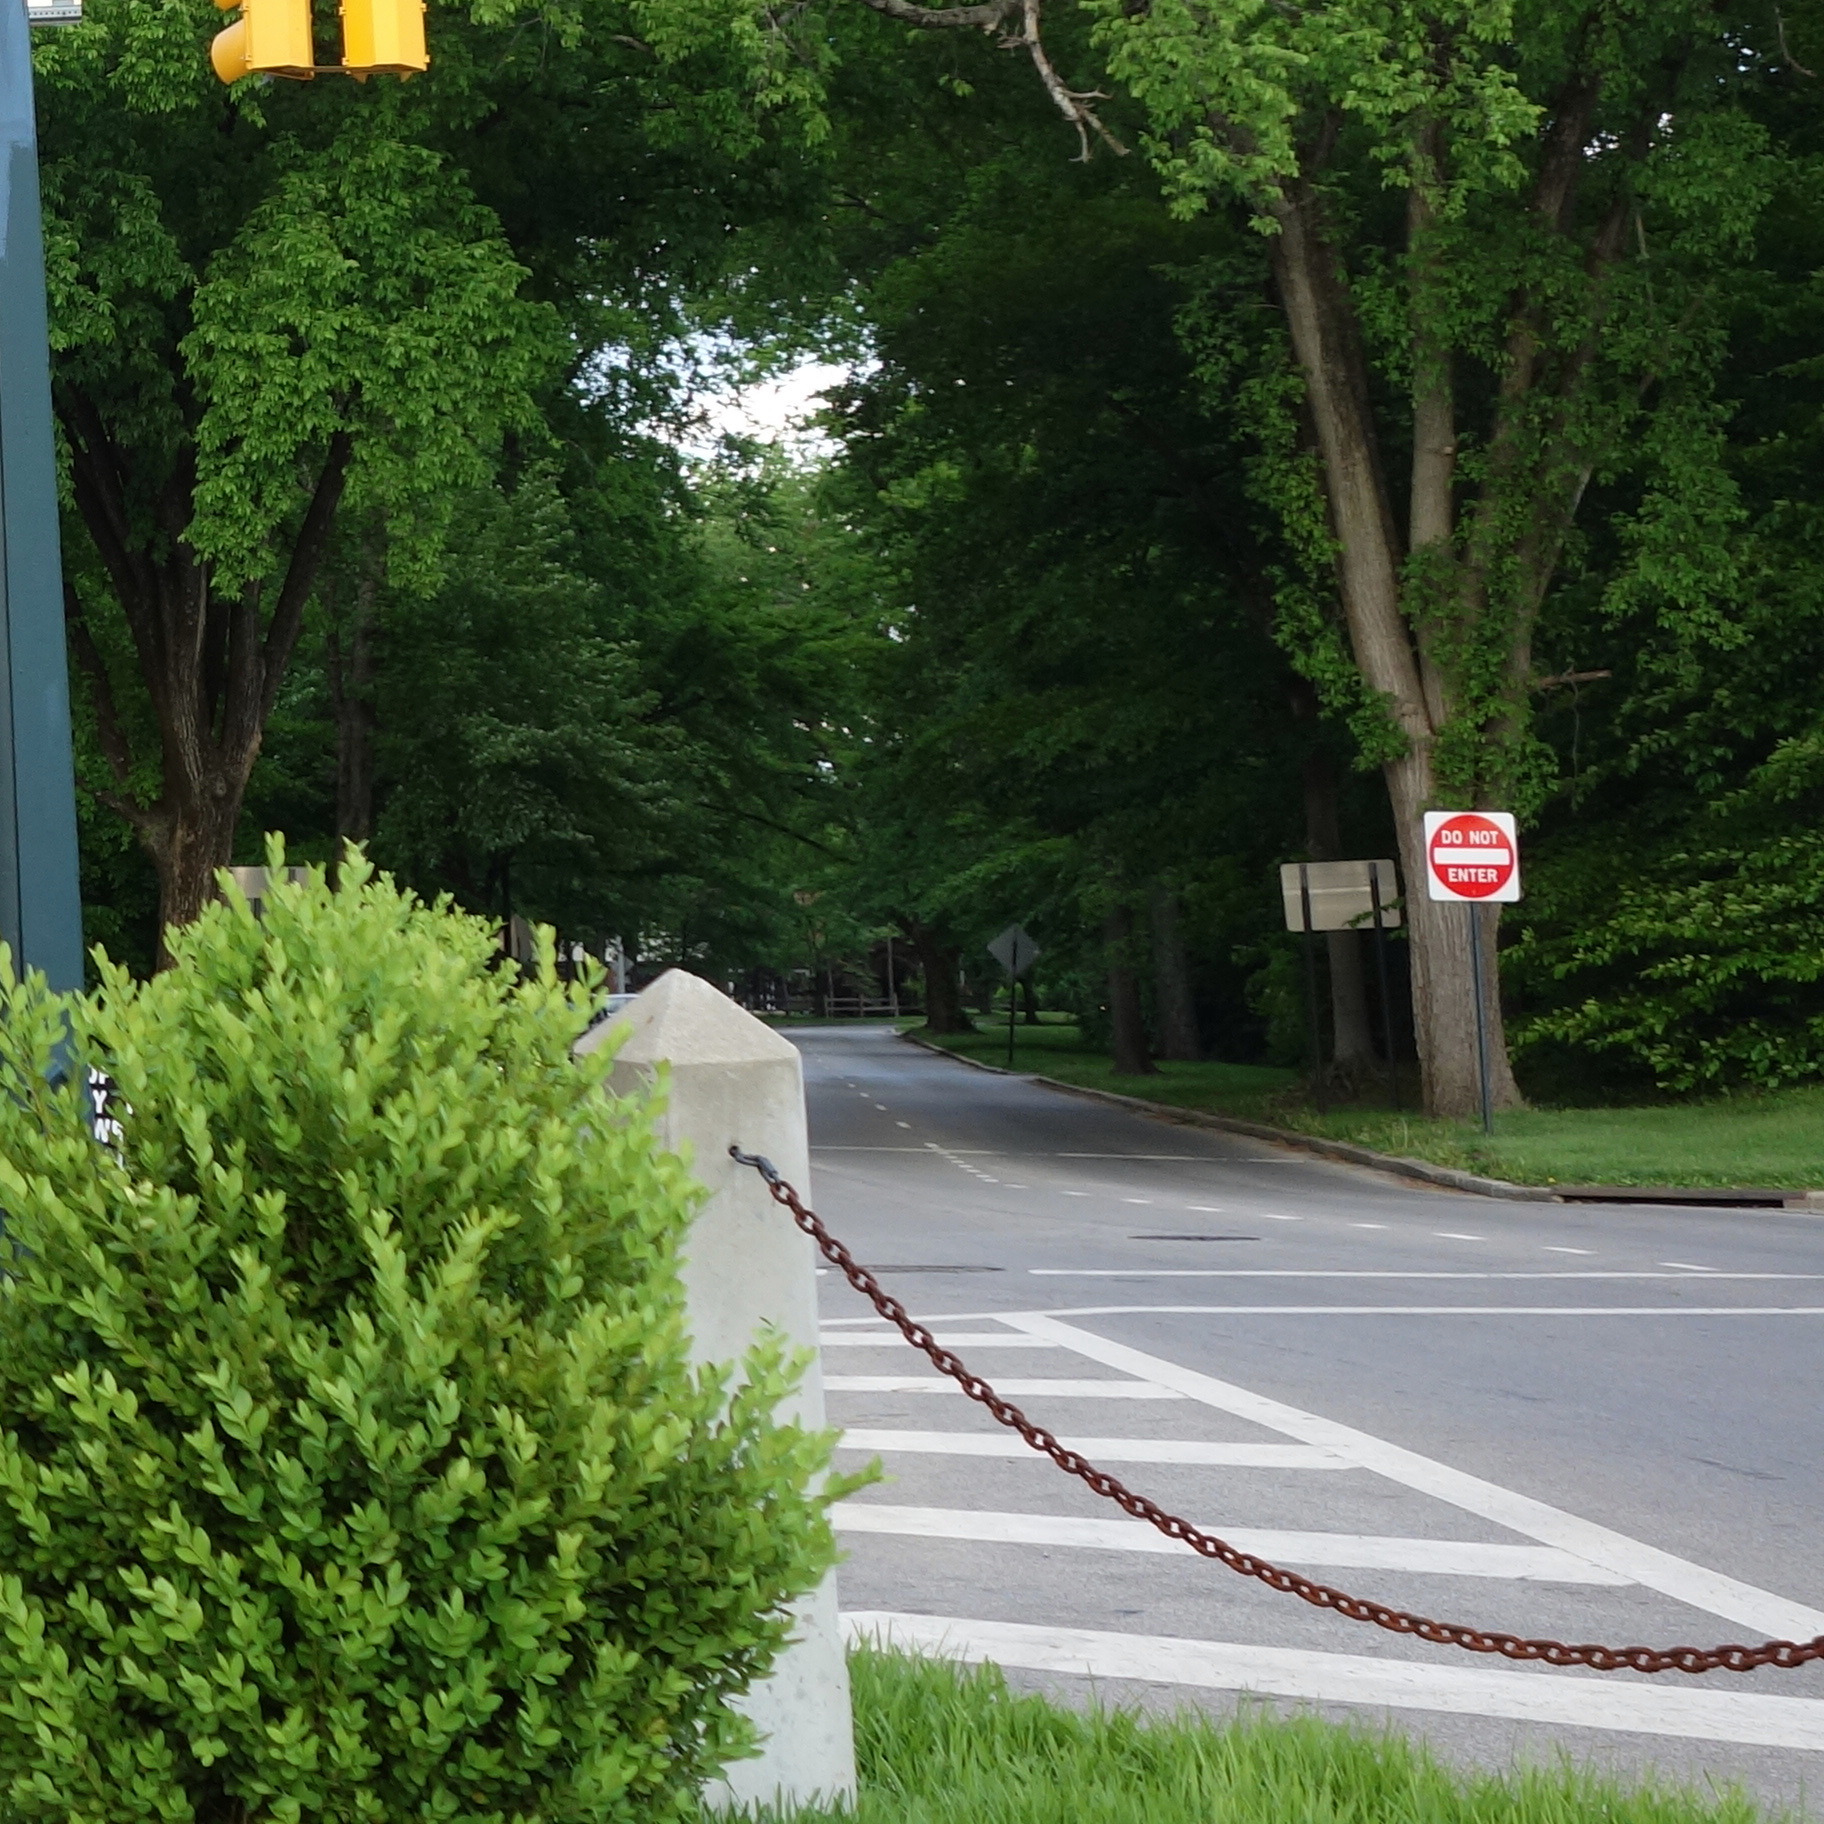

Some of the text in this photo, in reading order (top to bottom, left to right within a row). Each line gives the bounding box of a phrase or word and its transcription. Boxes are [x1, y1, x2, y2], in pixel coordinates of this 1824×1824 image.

[1442, 830, 1499, 845] DO NOT
[1448, 868, 1498, 883] ENTER
